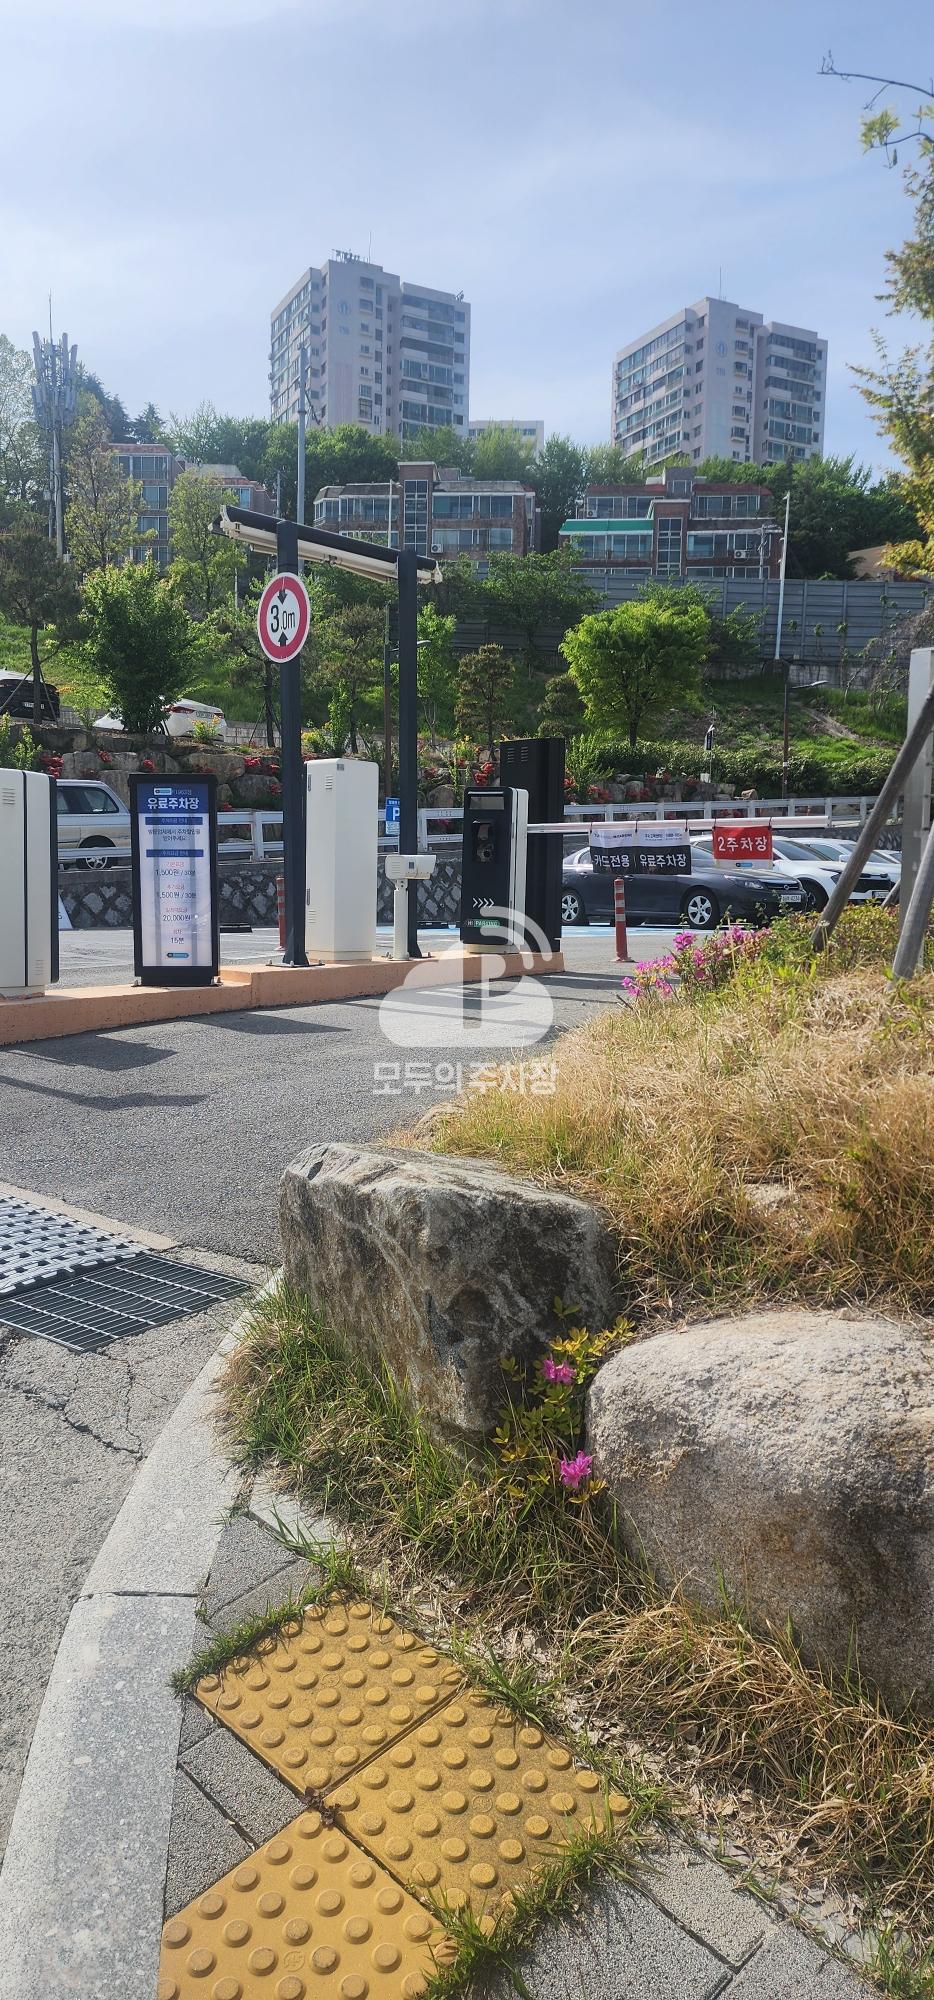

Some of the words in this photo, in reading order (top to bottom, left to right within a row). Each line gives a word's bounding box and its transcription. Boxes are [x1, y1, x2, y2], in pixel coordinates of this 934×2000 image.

[270, 604, 295, 633] 3.0m
[147, 797, 200, 810] 유료주차장
[717, 836, 768, 852] 2주차장
[594, 854, 630, 868] 카드전용
[639, 853, 687, 868] 유료주차장
[162, 914, 191, 922] 20,000원
